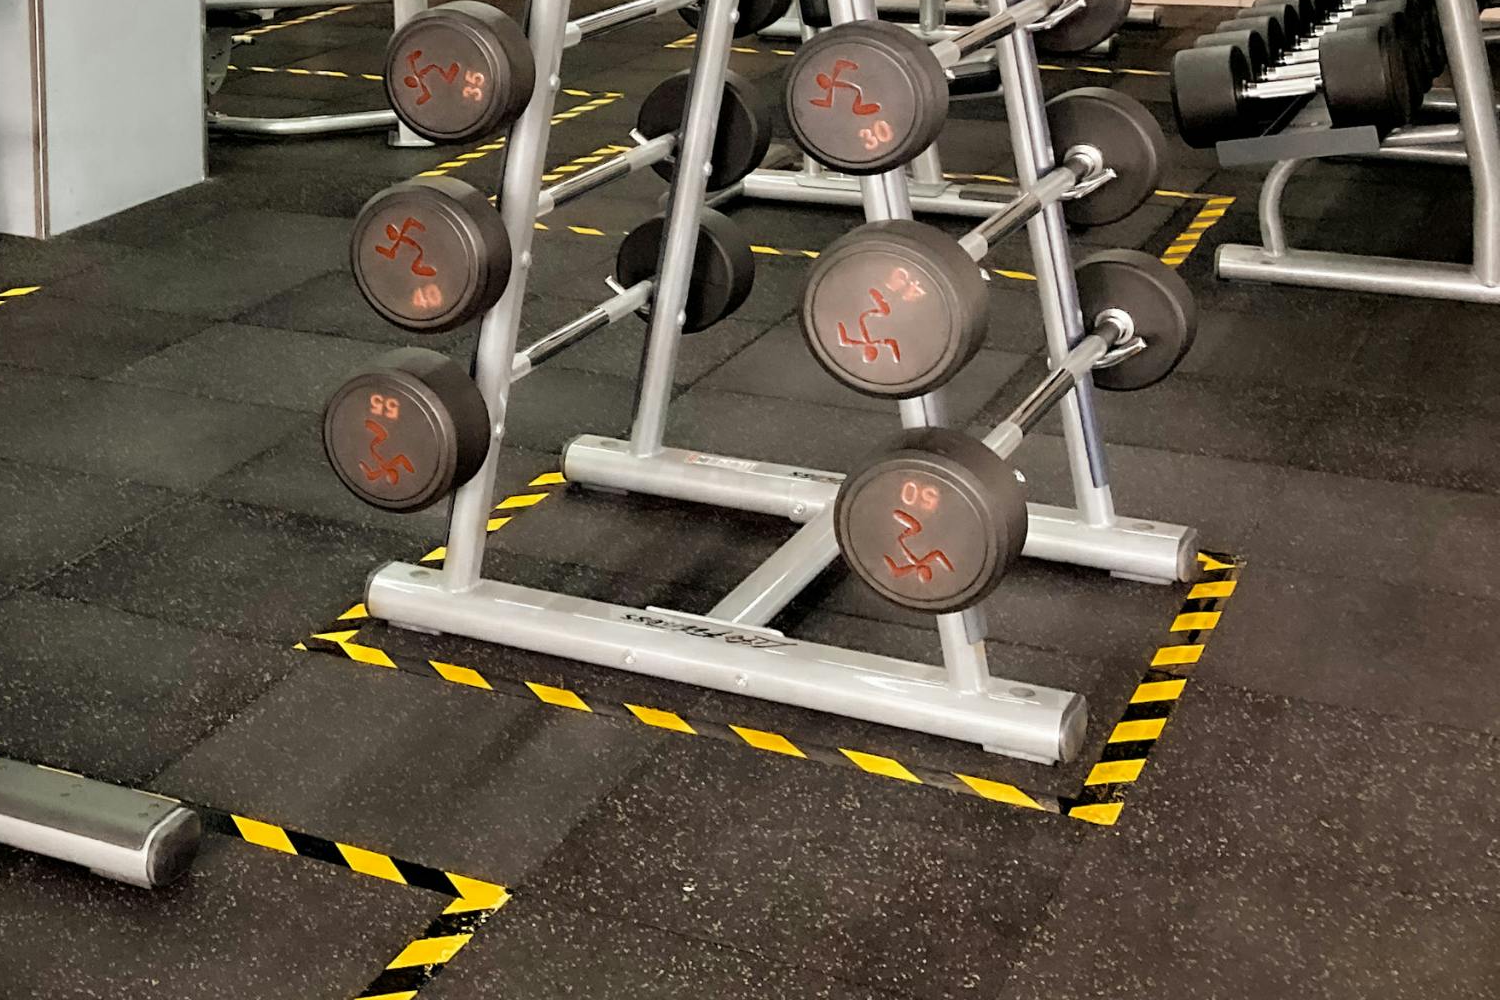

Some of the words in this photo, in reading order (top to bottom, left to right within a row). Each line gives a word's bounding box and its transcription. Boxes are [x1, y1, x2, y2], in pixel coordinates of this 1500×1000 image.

[462, 69, 485, 102] 35
[859, 119, 894, 151] 30
[412, 283, 443, 309] 40
[370, 394, 400, 420] 55
[901, 481, 938, 510] 50
